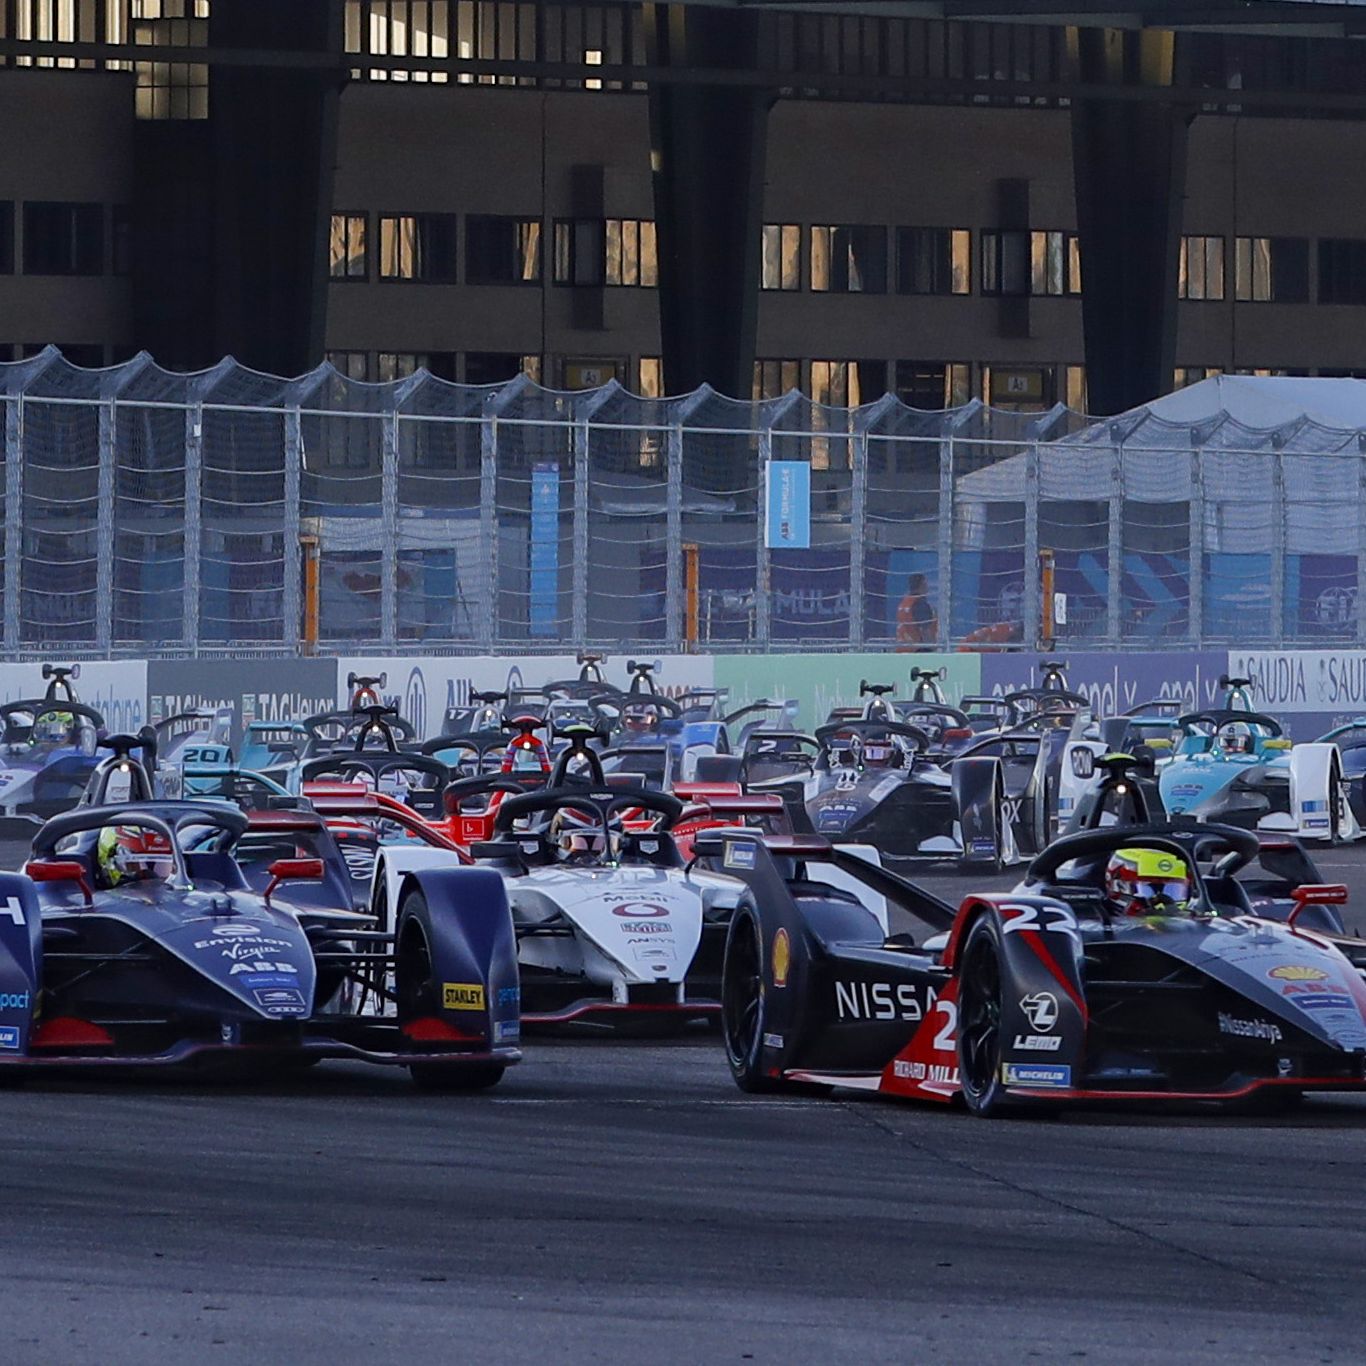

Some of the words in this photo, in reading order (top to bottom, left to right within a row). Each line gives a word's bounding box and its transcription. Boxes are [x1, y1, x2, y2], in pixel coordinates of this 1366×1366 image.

[1247, 657, 1307, 703] SAUDIA
[448, 709, 470, 720] 17
[183, 749, 220, 763] 20
[998, 903, 1080, 935] 22
[193, 936, 294, 950] Envision
[229, 961, 298, 976] ABB
[444, 986, 482, 1005] STANLEY
[1012, 1034, 1063, 1051] LEMO
[893, 1059, 927, 1080] RICHARD
[1018, 1069, 1066, 1081] MICHELIN
